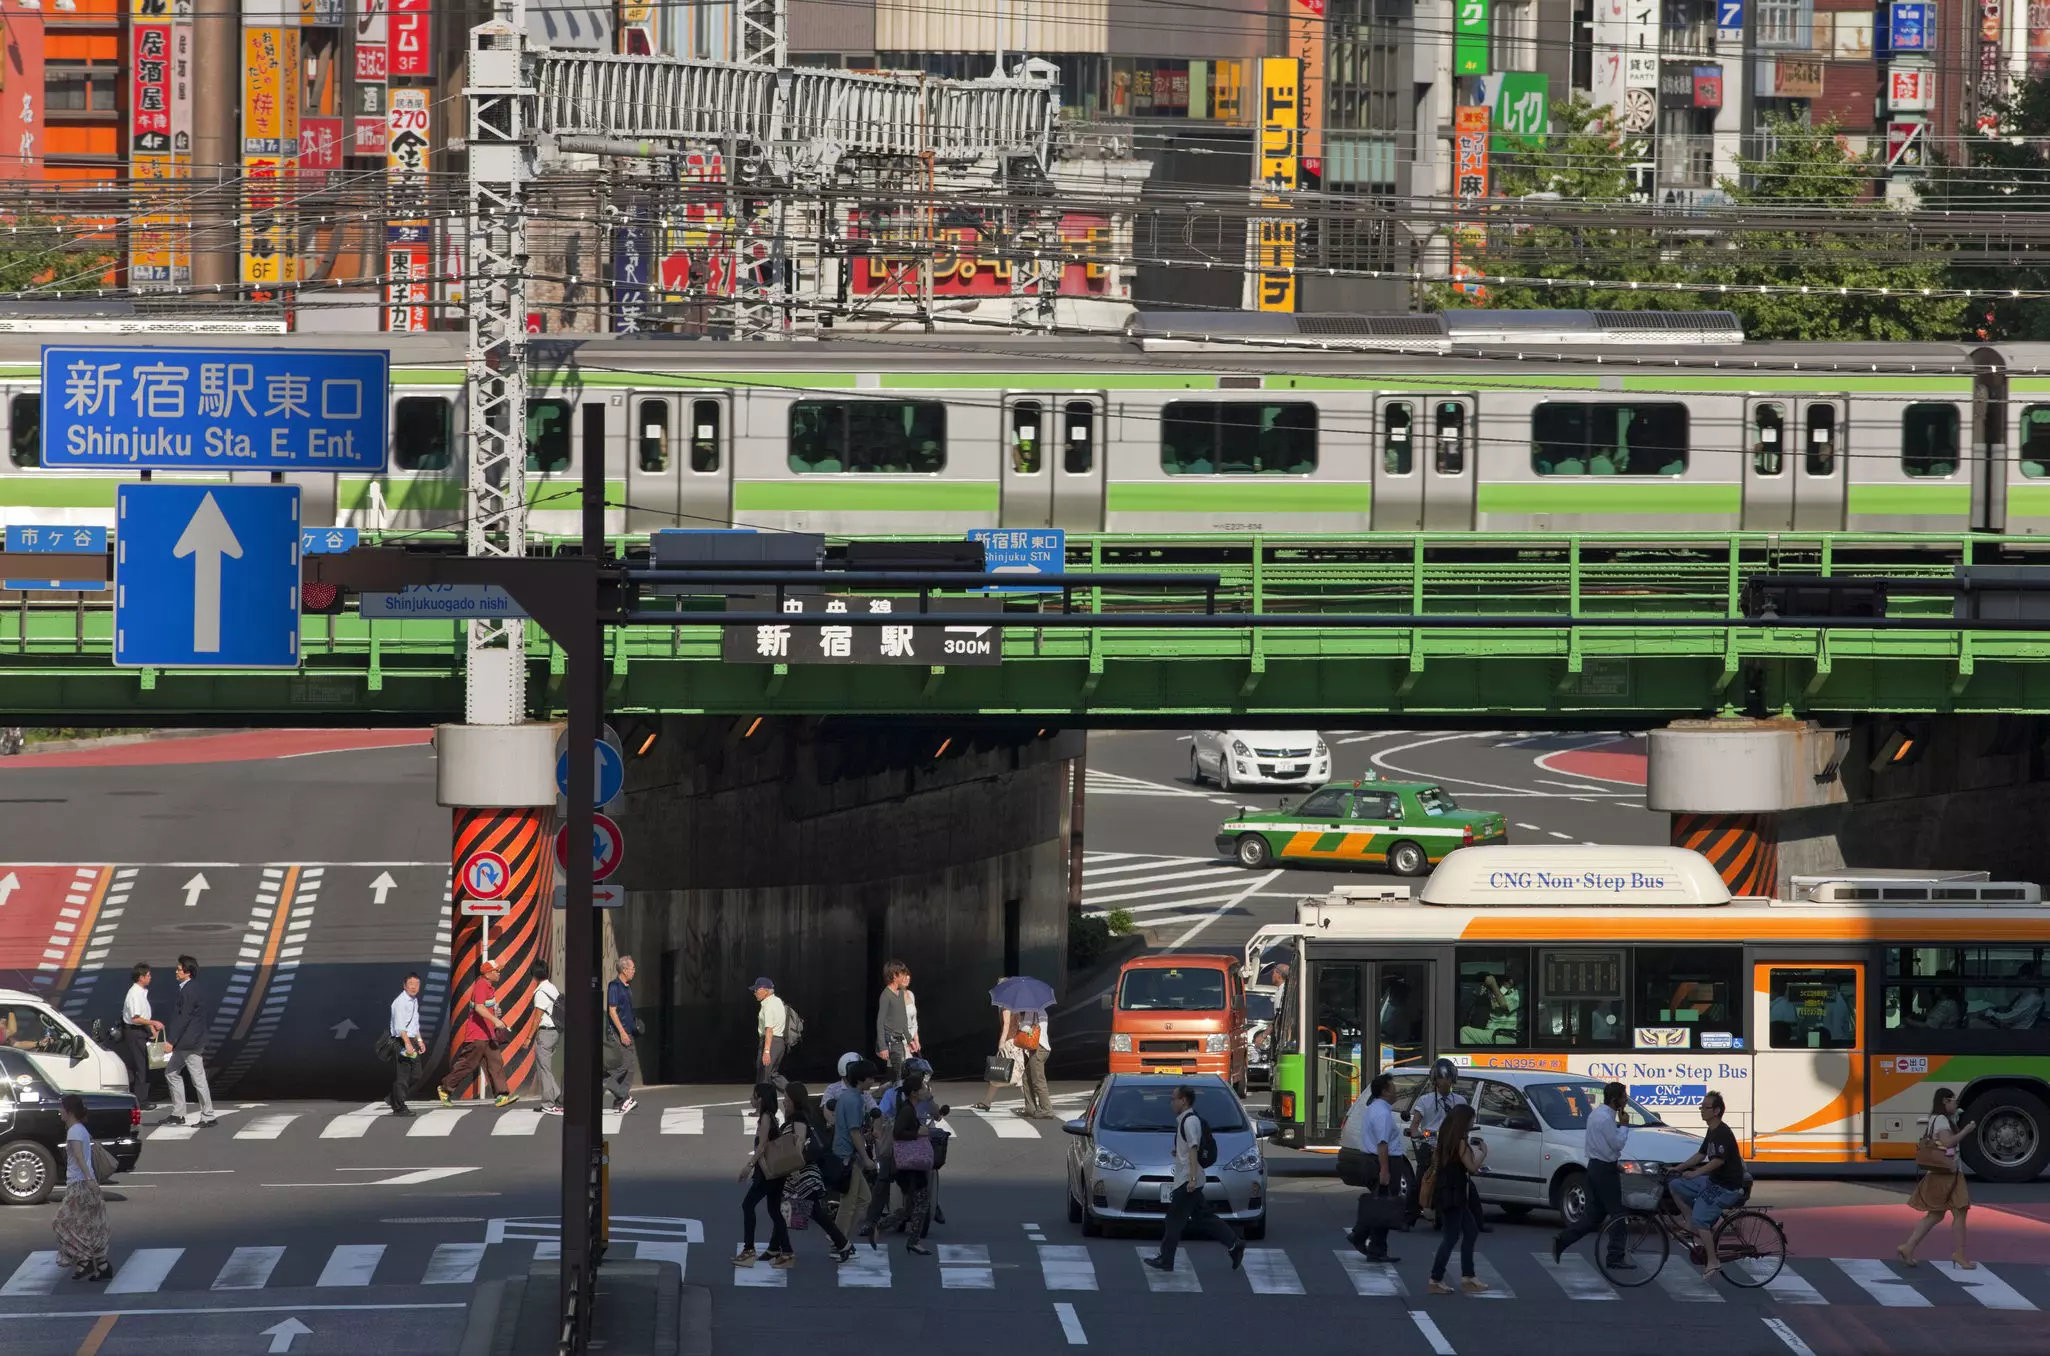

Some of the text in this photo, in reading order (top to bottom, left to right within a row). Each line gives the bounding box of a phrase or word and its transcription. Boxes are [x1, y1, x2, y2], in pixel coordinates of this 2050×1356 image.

[1721, 4, 1740, 25] 7
[139, 31, 165, 111] 居酒屋
[356, 51, 385, 76] たばこ
[398, 57, 419, 70] 3F
[1629, 73, 1655, 81] PARTY
[363, 86, 379, 112] 酒
[391, 109, 428, 129] 270
[1503, 91, 1544, 134] レイク
[140, 133, 164, 149] 4F
[266, 139, 278, 151] 7F
[302, 124, 333, 165] 本陣
[154, 266, 167, 279] 7F
[251, 262, 271, 279] 6F
[64, 360, 362, 419] 新宿駅東口
[66, 424, 362, 462] Shinjuku Sta. E. Ent.
[1030, 552, 1051, 561] STN
[385, 596, 508, 612] Shinjukuogado nishi
[756, 625, 915, 657] 新宿駅
[943, 639, 991, 655] 300M
[1489, 872, 1532, 889] CNG
[1630, 872, 1665, 889] Bus
[1588, 1062, 1628, 1079] CNG
[1717, 1063, 1748, 1079] Bus
[1909, 1058, 1926, 1067] 出口
[1655, 1085, 1682, 1096] CNG
